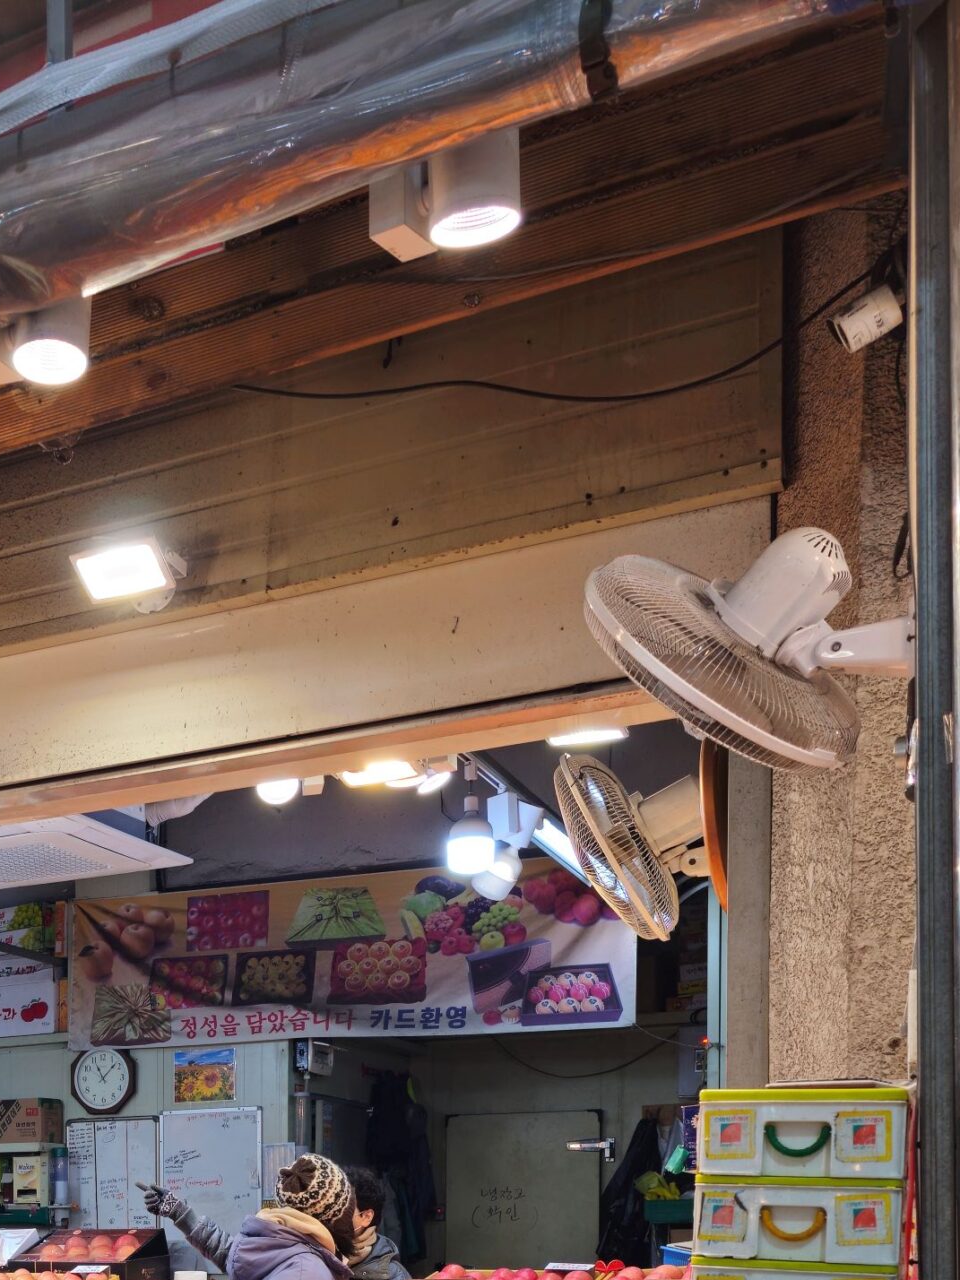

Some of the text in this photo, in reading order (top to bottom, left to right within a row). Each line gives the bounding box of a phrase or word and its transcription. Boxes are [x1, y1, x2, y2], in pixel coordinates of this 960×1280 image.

[180, 1004, 468, 1040] 정성을 담았습니다 카드환영
